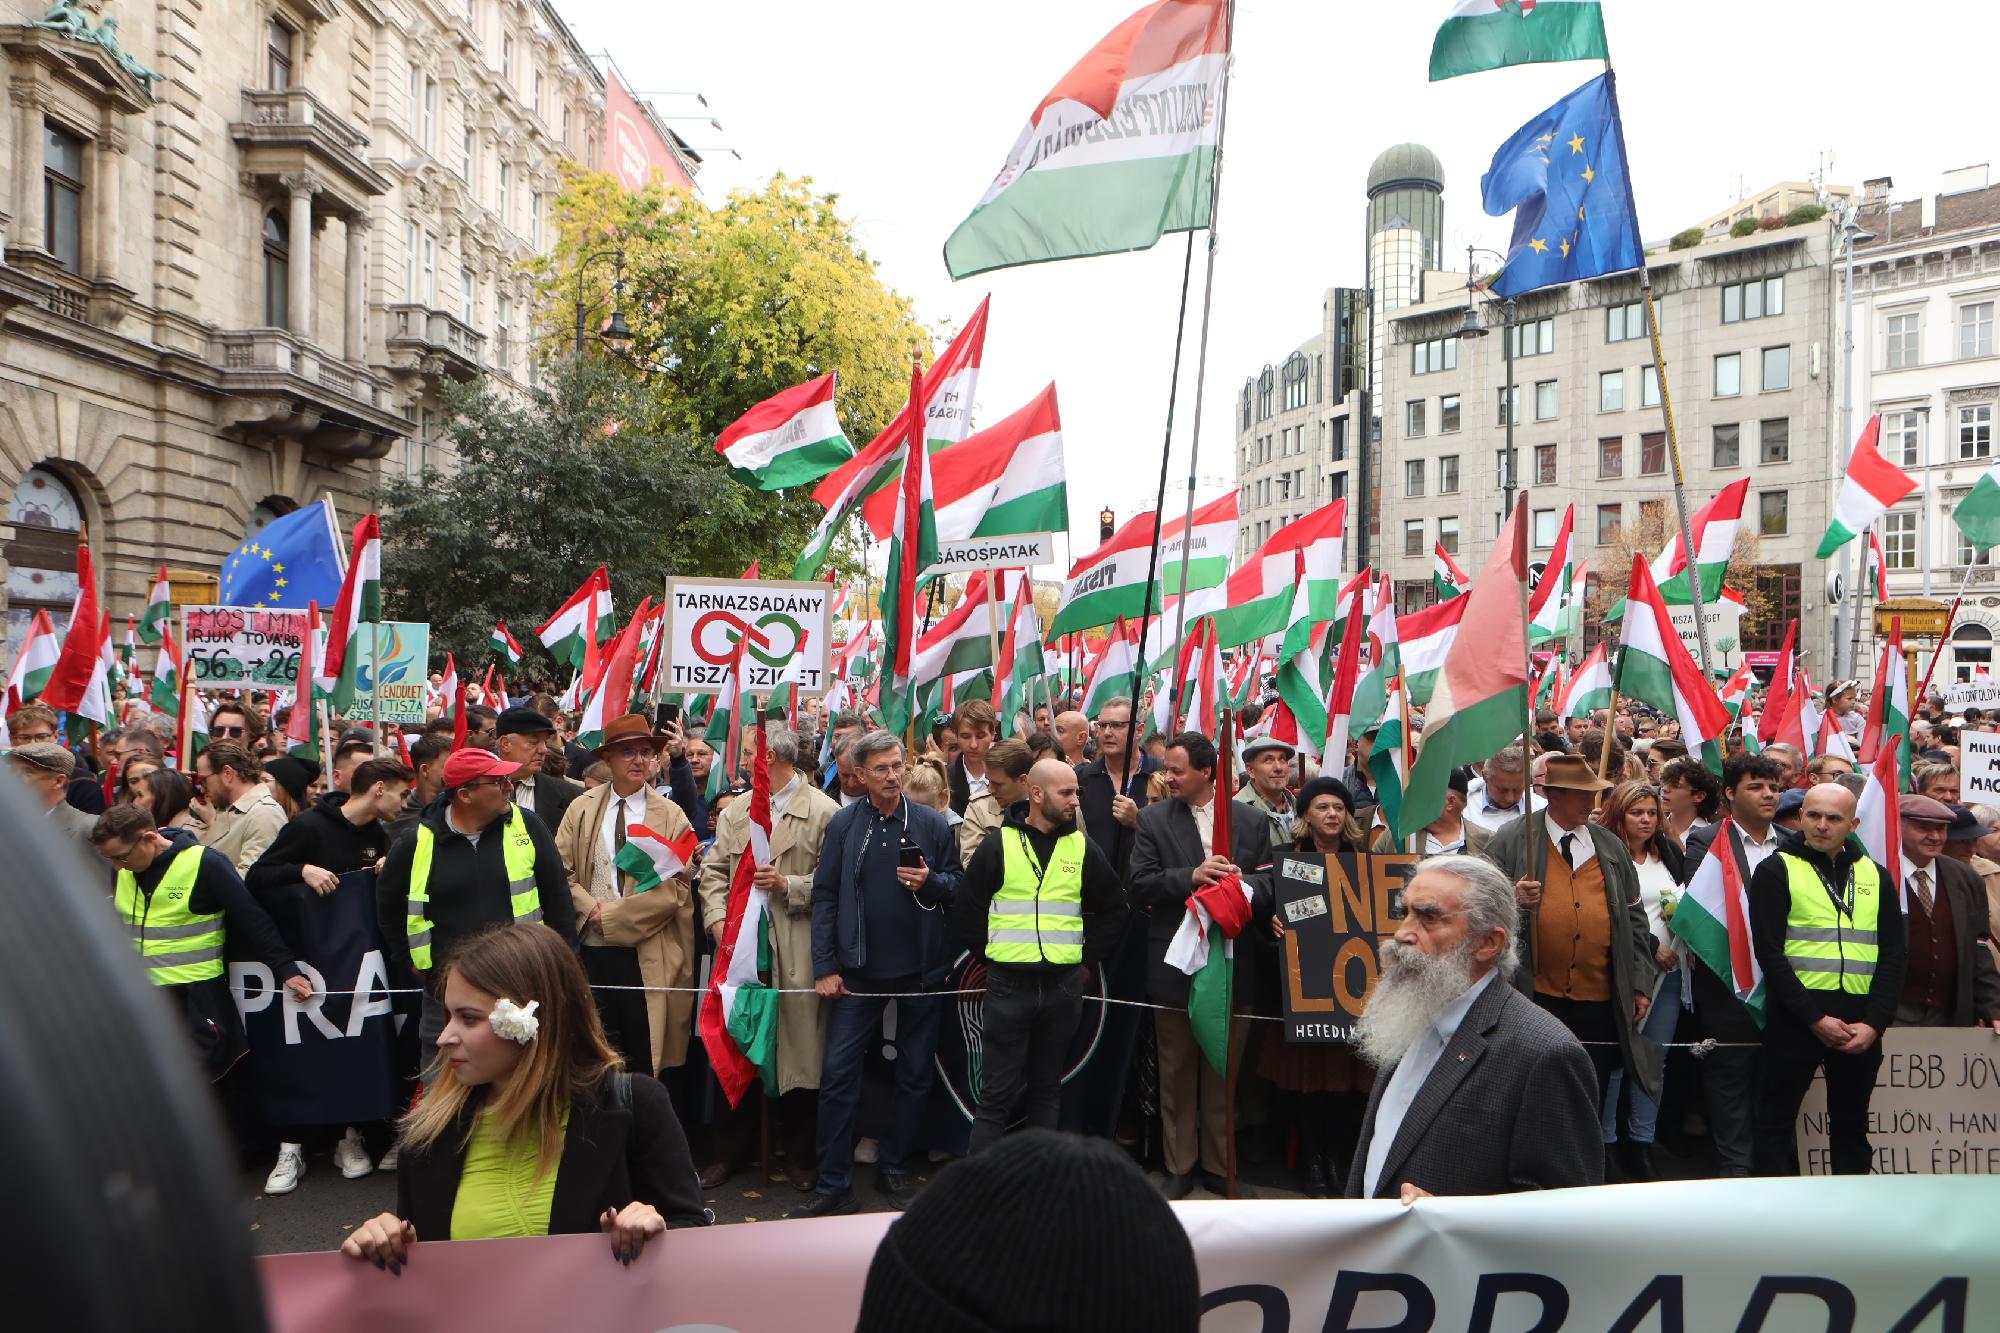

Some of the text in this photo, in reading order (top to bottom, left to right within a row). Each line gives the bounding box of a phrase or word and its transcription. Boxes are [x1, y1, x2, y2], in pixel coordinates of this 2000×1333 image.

[938, 543, 1039, 564] SÁROSPATAK
[675, 593, 823, 613] TARNAZSADÁNY
[199, 608, 260, 630] MOST
[267, 649, 301, 681] 26
[386, 699, 423, 713] TISZA
[1949, 1112, 2000, 1134] HAN
